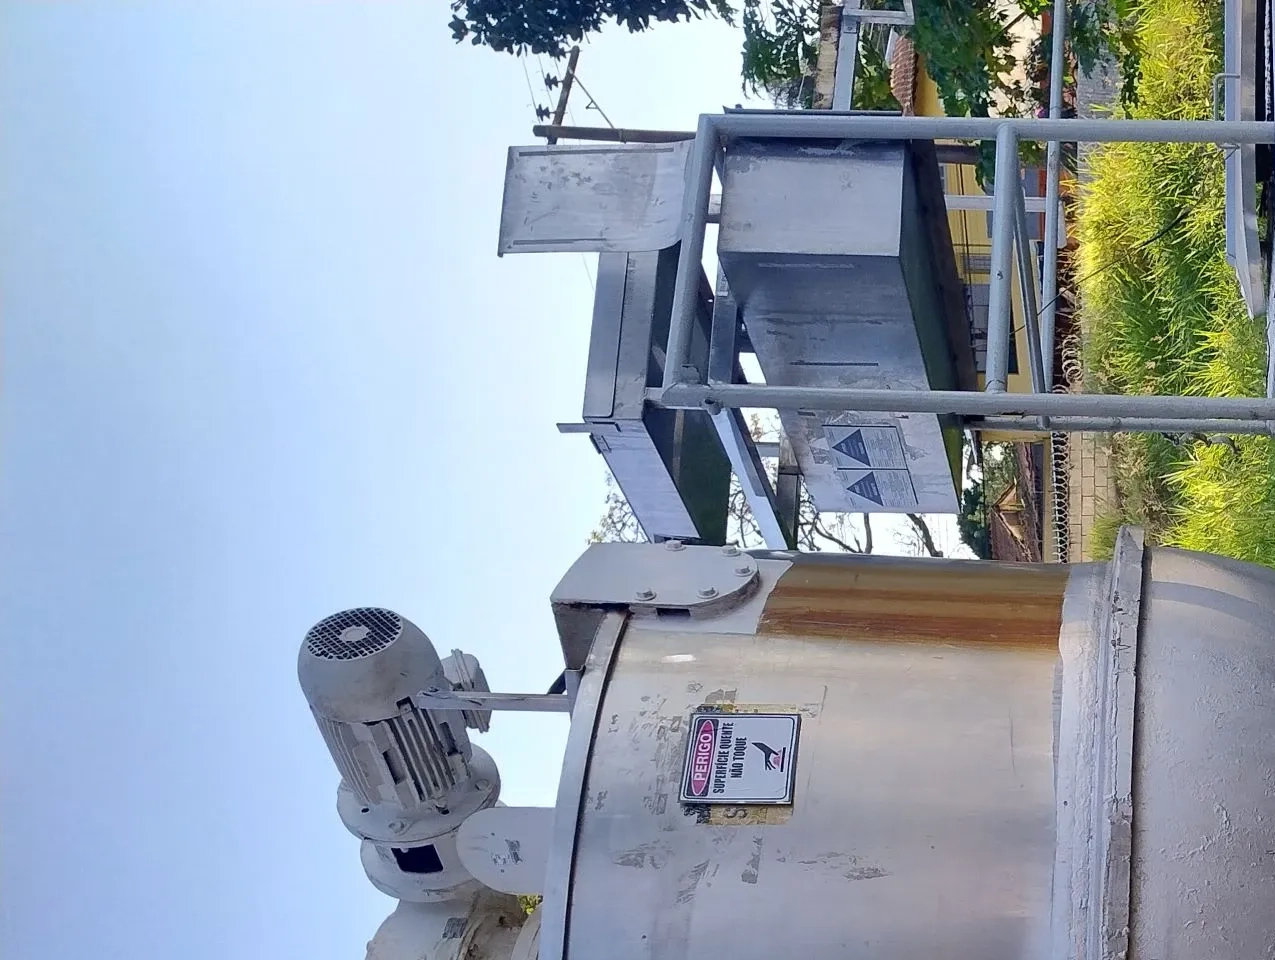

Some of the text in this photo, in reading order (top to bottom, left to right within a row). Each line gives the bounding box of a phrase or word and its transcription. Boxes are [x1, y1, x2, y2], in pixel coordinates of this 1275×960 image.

[693, 733, 712, 780] PERIGO
[713, 722, 734, 793] SUPERFÍCIE QUENTE
[729, 737, 747, 778] NÃO TOQUE
